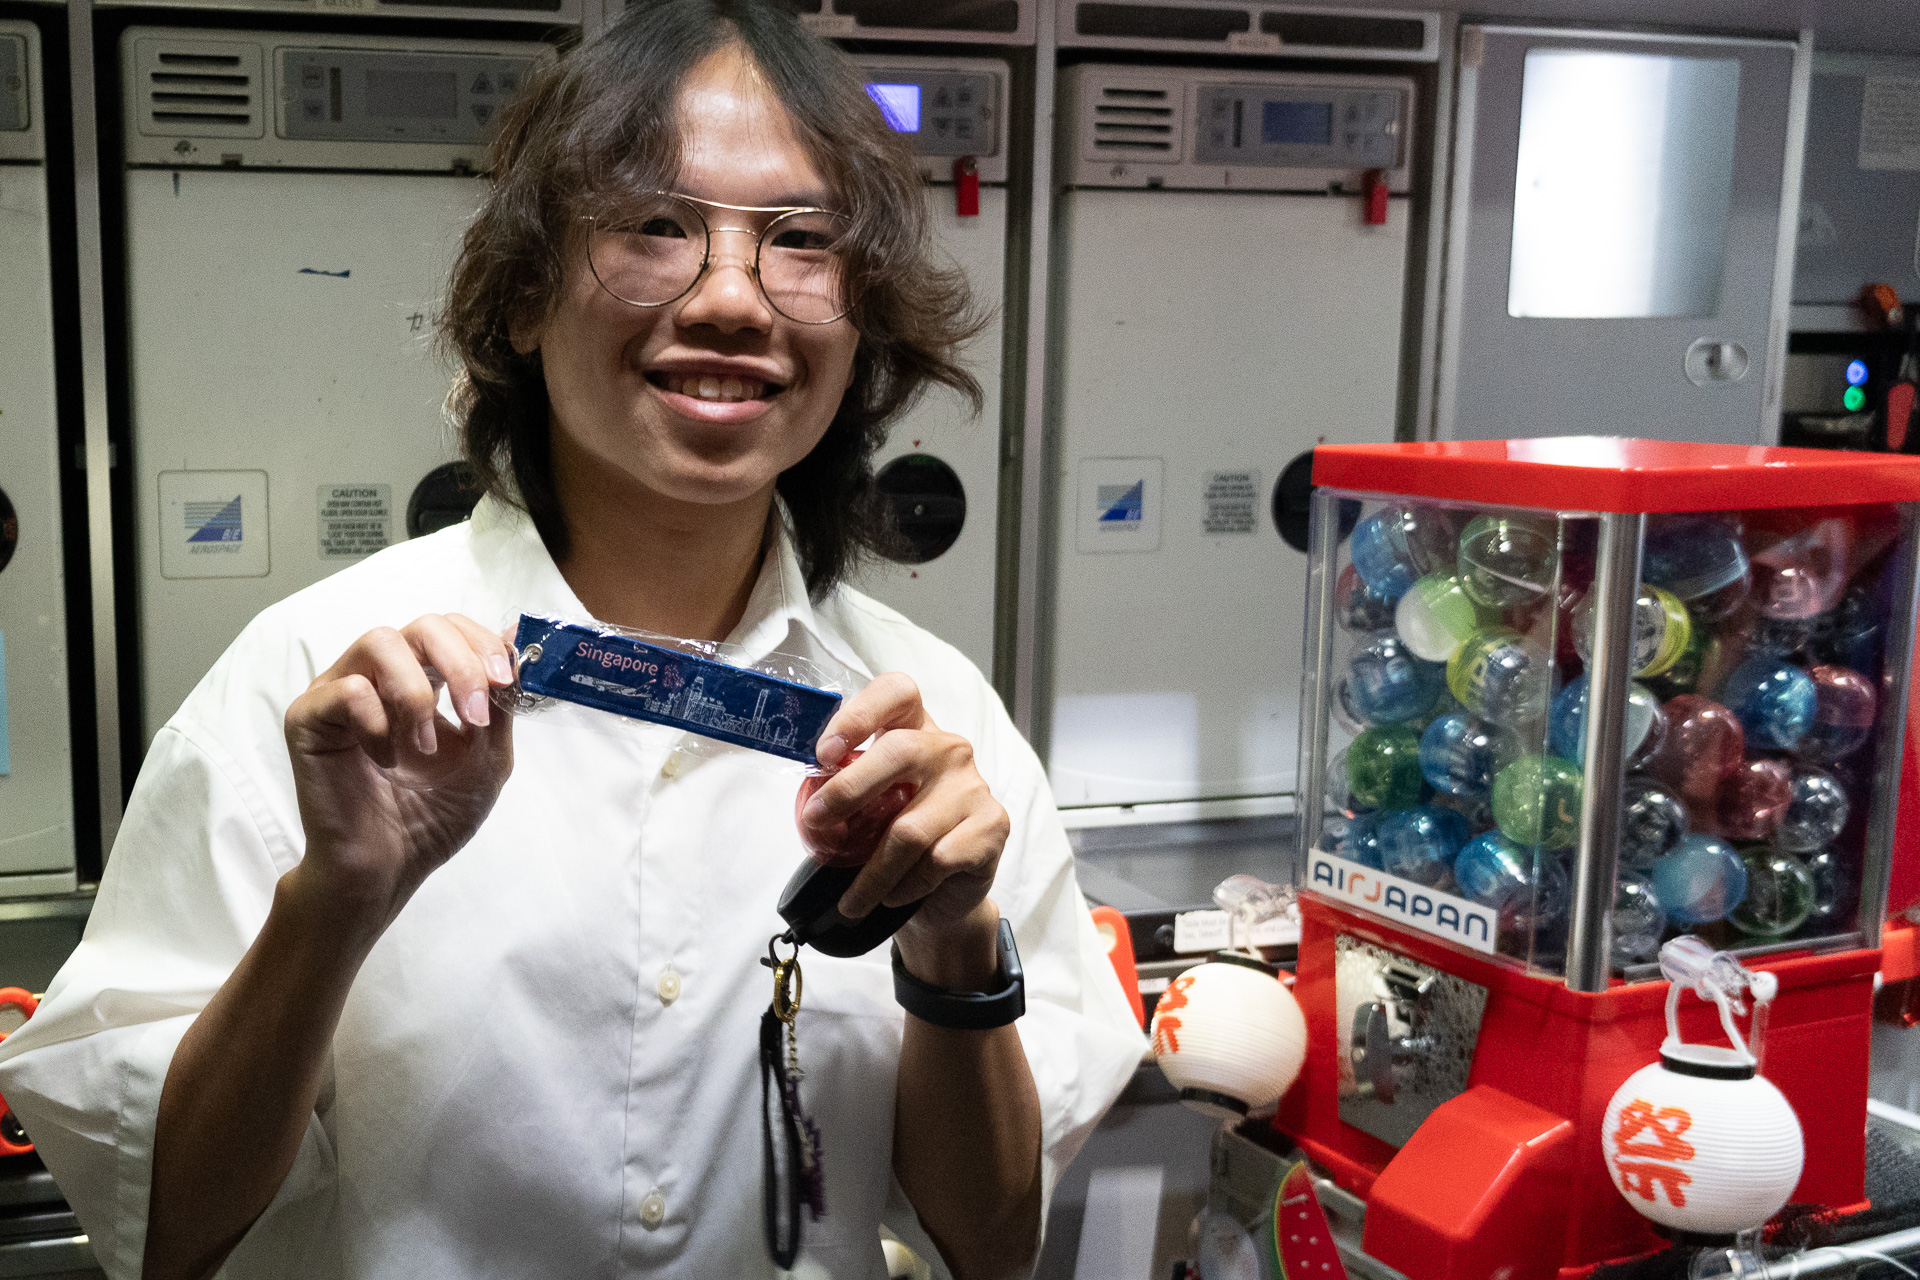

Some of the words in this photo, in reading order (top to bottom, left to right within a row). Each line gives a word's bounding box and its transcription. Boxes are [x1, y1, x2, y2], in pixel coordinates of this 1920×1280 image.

[1213, 474, 1249, 482] CAUTION
[332, 489, 377, 498] CAUTION
[189, 544, 242, 554] AEROSPACE
[575, 641, 659, 677] Singapore
[1613, 1098, 1696, 1208] 祭
